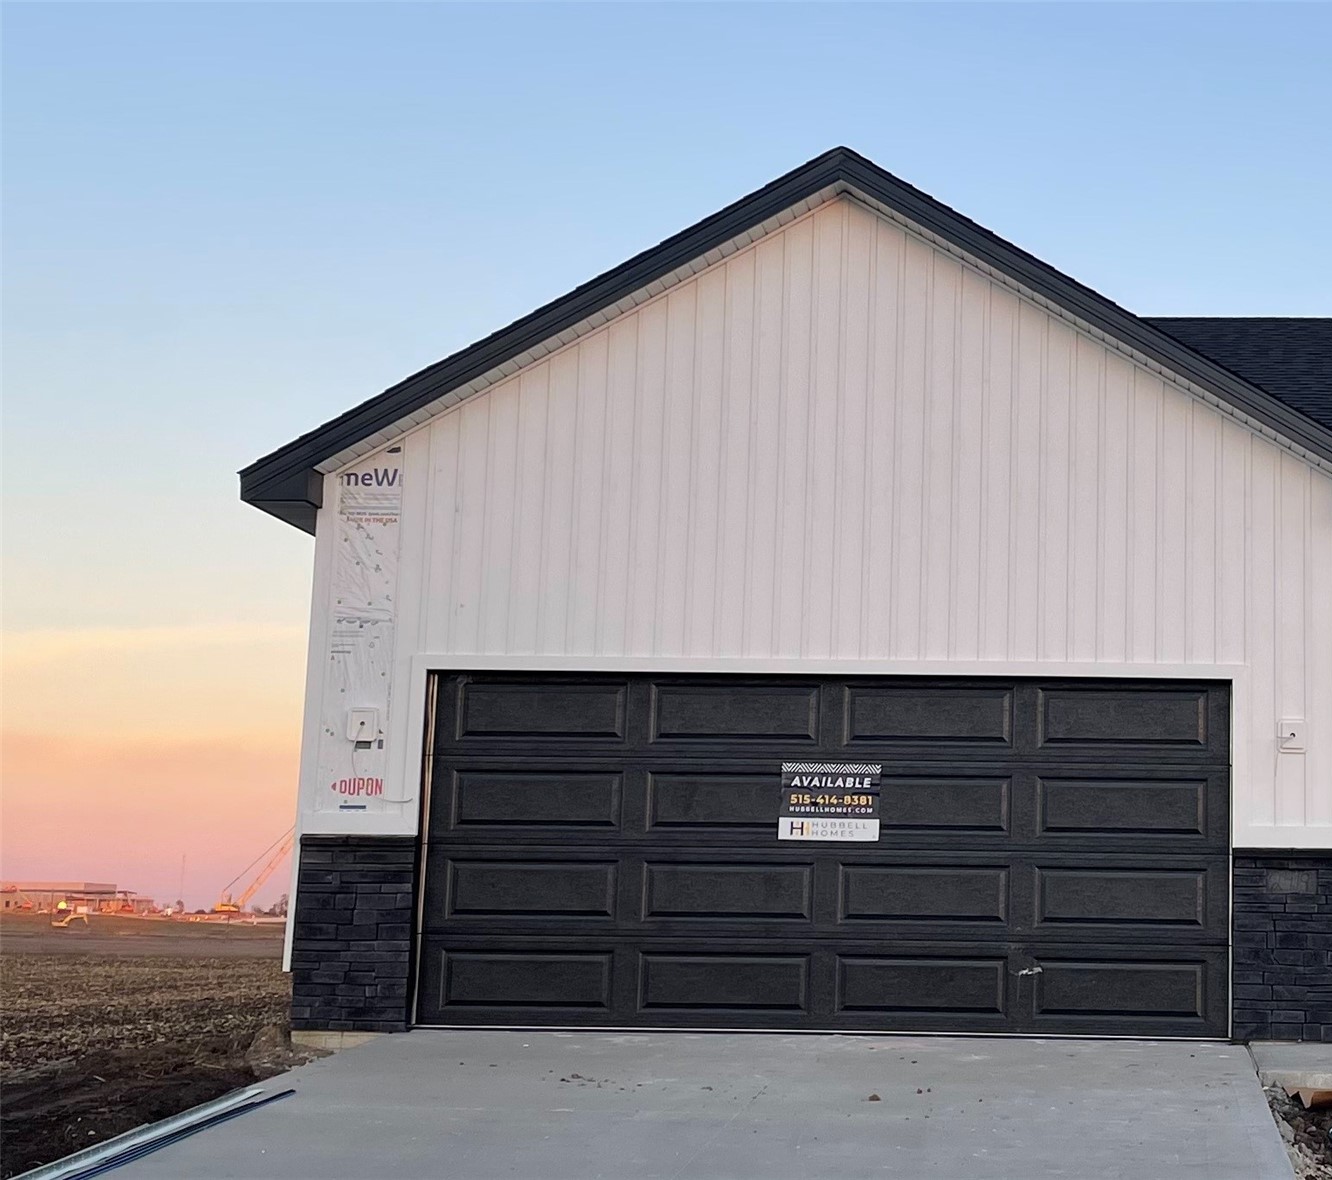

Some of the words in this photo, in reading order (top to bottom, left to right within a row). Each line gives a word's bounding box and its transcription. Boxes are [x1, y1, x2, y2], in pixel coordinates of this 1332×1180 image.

[791, 776, 872, 788] AVAILABLE
[789, 806, 873, 814] HUBBELLHOMES.COM
[812, 822, 867, 830] HUBBELL
